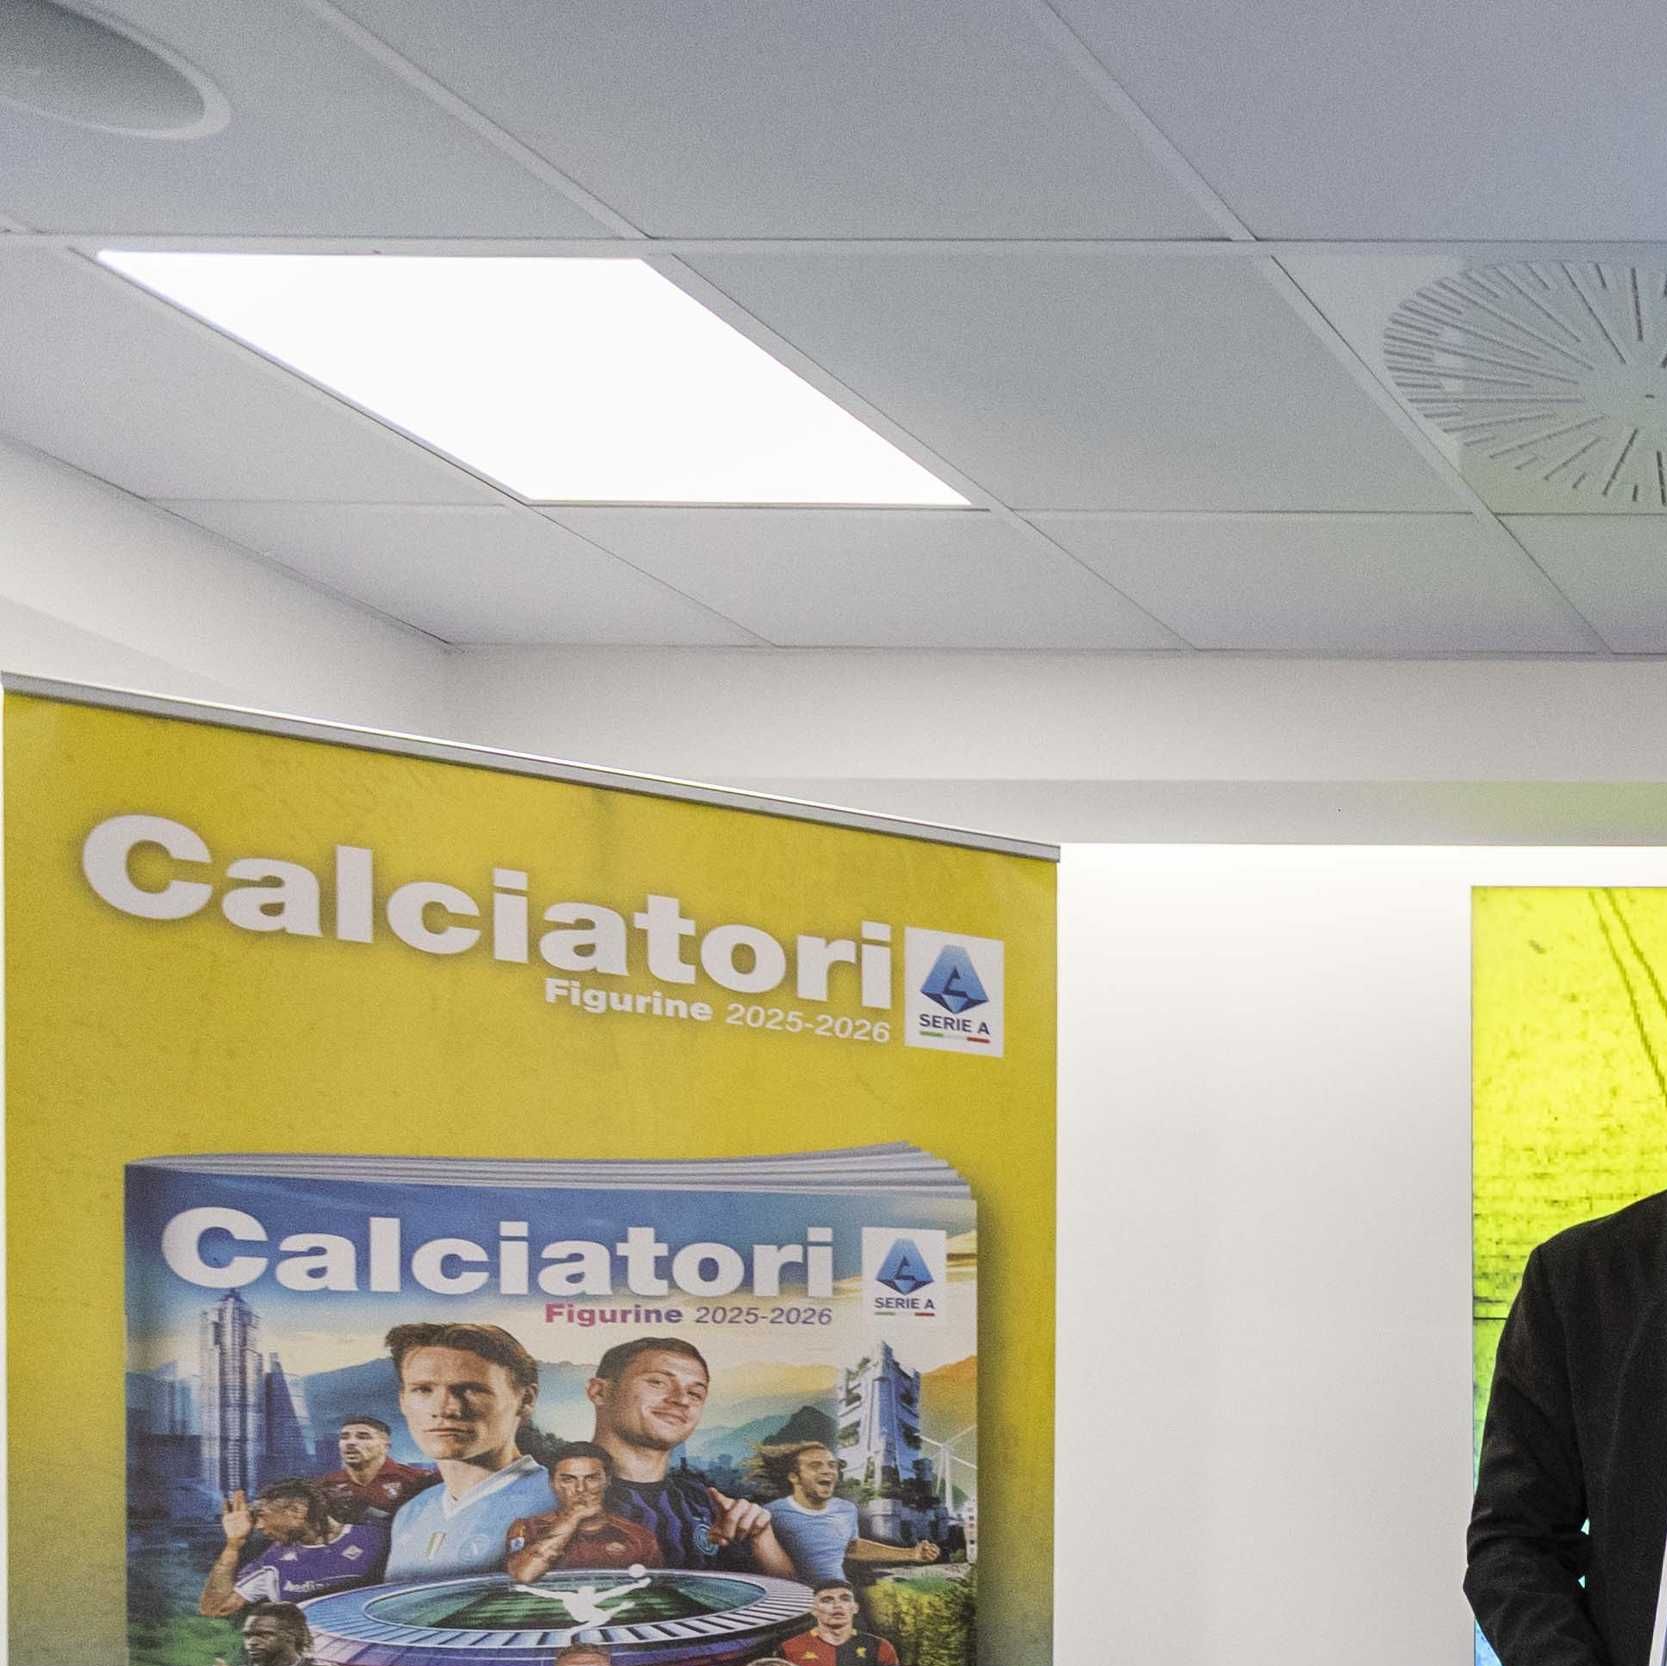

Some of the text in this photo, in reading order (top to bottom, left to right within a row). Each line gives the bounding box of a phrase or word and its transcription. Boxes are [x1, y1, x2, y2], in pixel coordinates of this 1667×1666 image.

[83, 814, 892, 1010] Calciatori
[544, 977, 891, 1044] Figurine 2025-2026
[918, 1013, 990, 1036] SERIE A
[160, 1206, 834, 1299] Calciatori
[544, 1302, 833, 1328] Figurine 2025-2026
[874, 1297, 935, 1310] SERIE A
